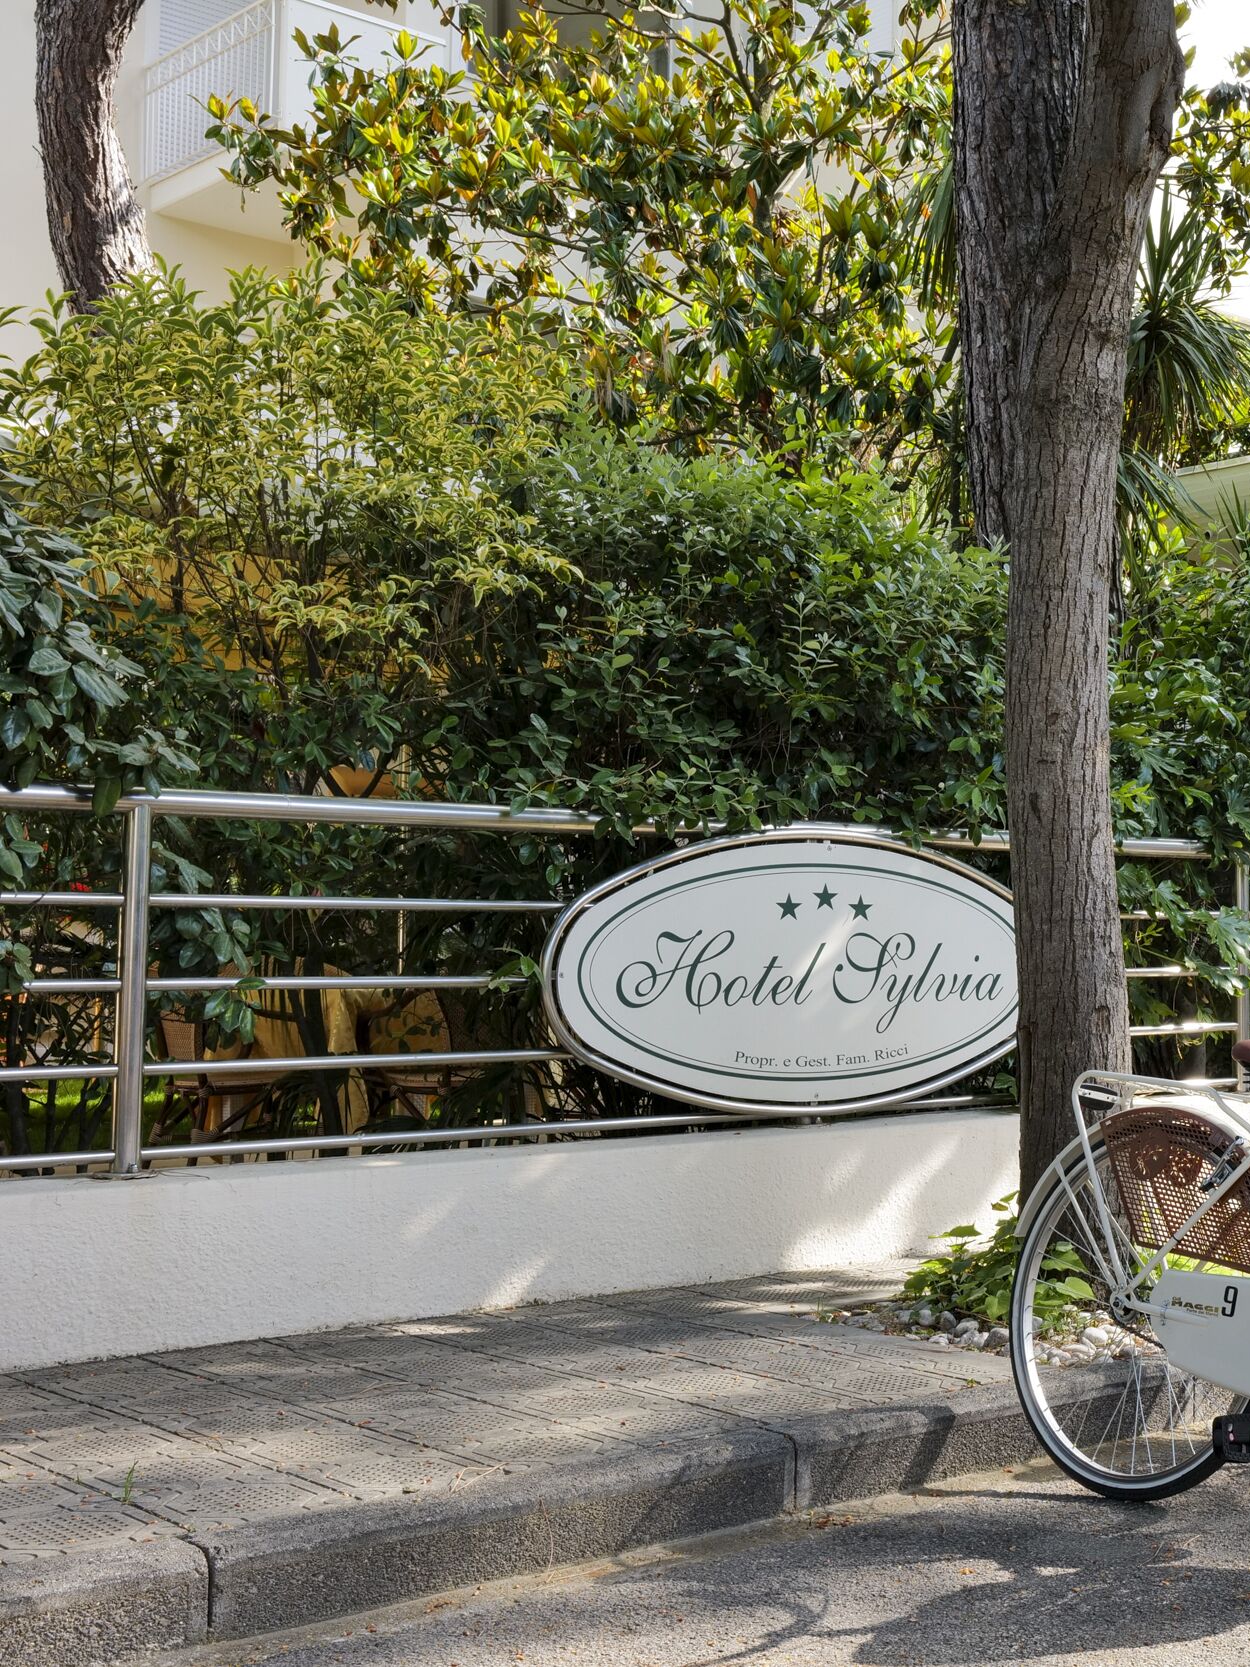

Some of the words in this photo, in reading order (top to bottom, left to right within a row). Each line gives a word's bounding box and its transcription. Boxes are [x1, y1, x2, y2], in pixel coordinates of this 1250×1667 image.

[615, 929, 826, 1015] Hotel
[832, 932, 1004, 1034] Sylvia
[734, 1050, 779, 1069] Propr.
[783, 1058, 792, 1068] e
[795, 1055, 832, 1068] Gest.
[836, 1053, 871, 1066] Fam.
[874, 1043, 909, 1062] Ricci
[1171, 1300, 1220, 1313] MAGGI
[1221, 1285, 1239, 1318] 9
